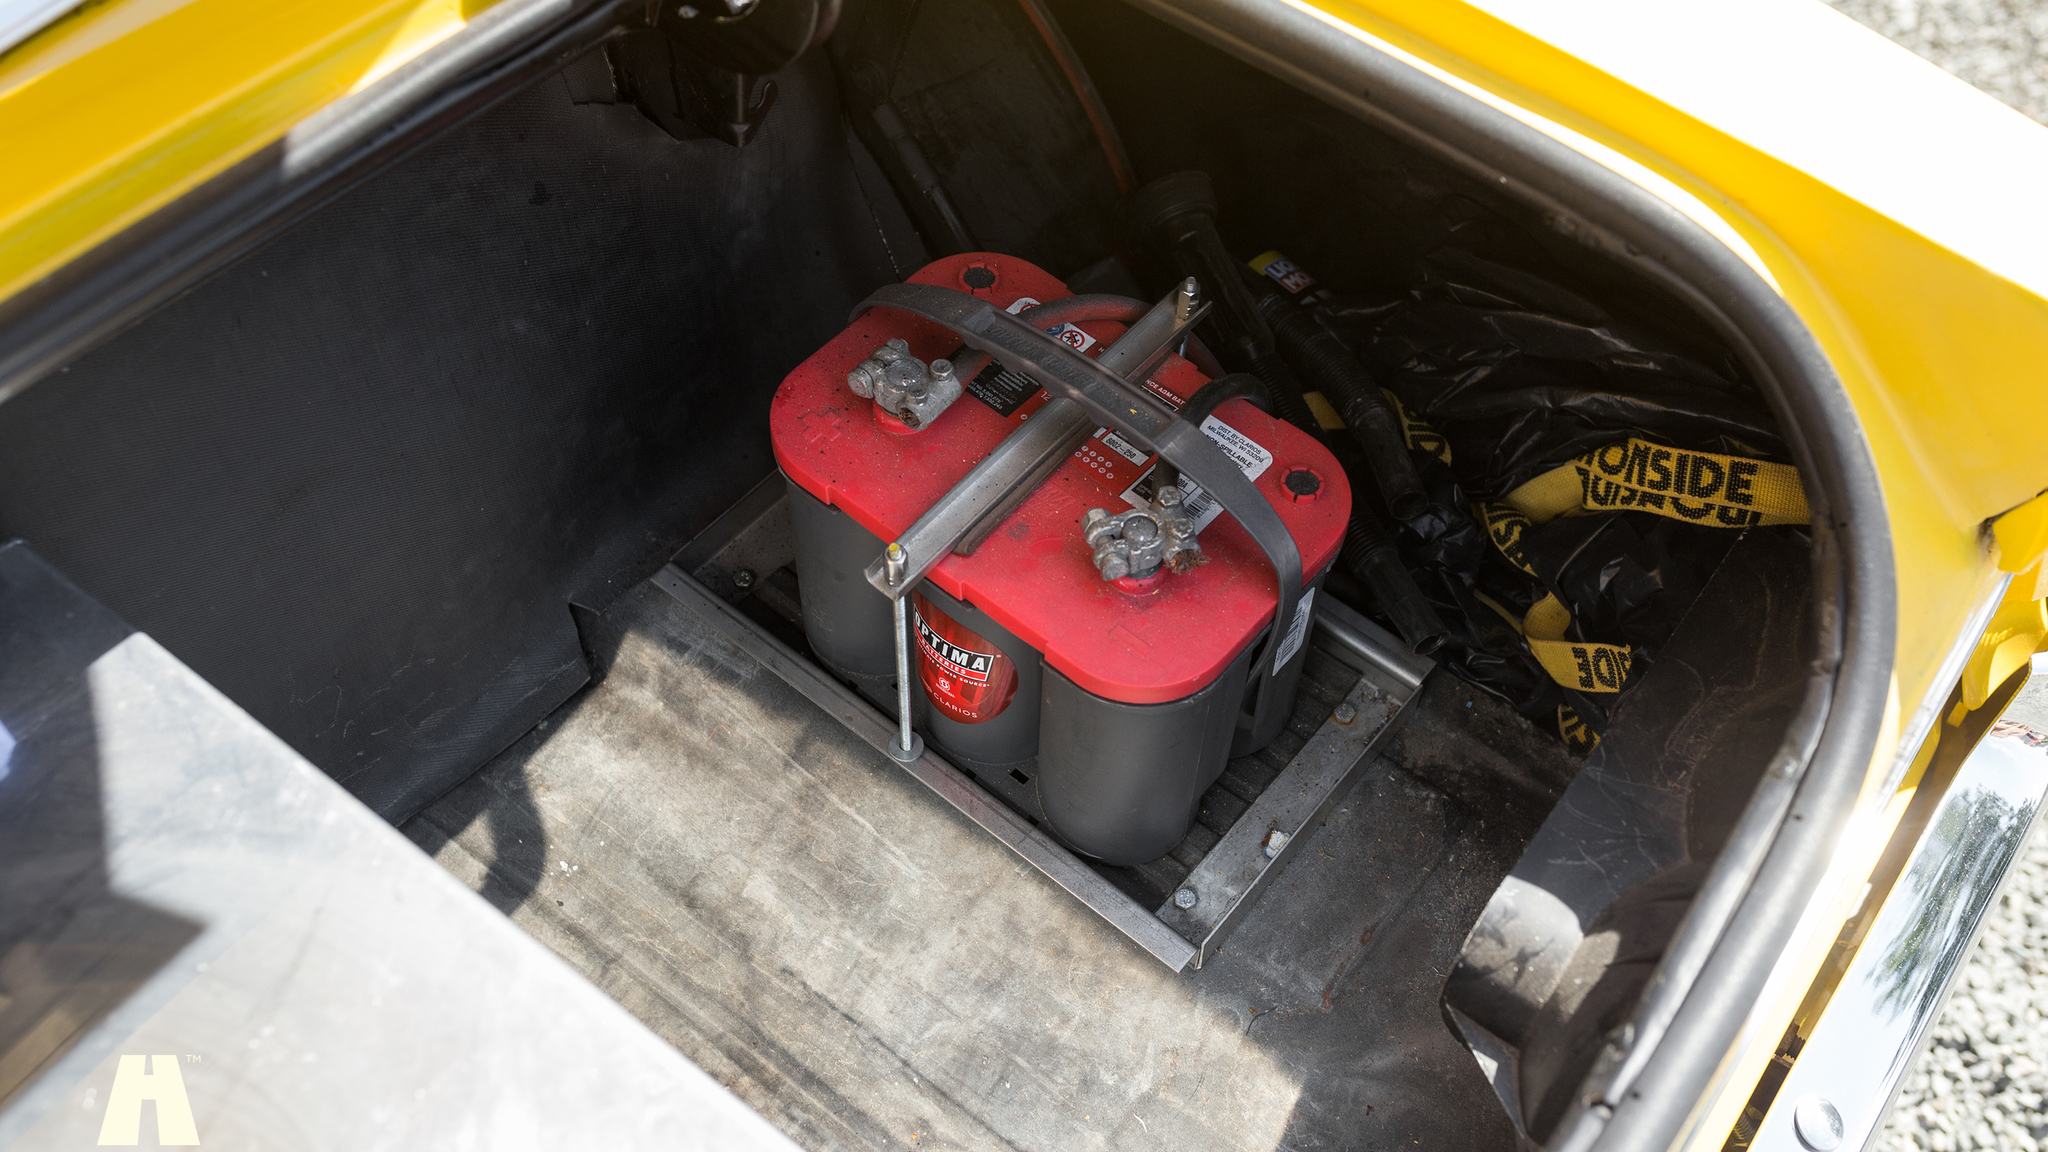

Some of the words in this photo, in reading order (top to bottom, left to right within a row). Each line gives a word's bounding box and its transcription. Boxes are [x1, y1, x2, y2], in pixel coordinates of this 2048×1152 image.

[1158, 386, 1173, 398] AGM
[1171, 394, 1186, 405] BAT
[1239, 444, 1247, 452] WI
[1240, 438, 1262, 455] CLARIOS
[914, 611, 985, 671] OPTIMA
[921, 637, 966, 675] BATTERIES
[936, 664, 957, 679] POWER
[933, 692, 978, 719] CLARIOS
